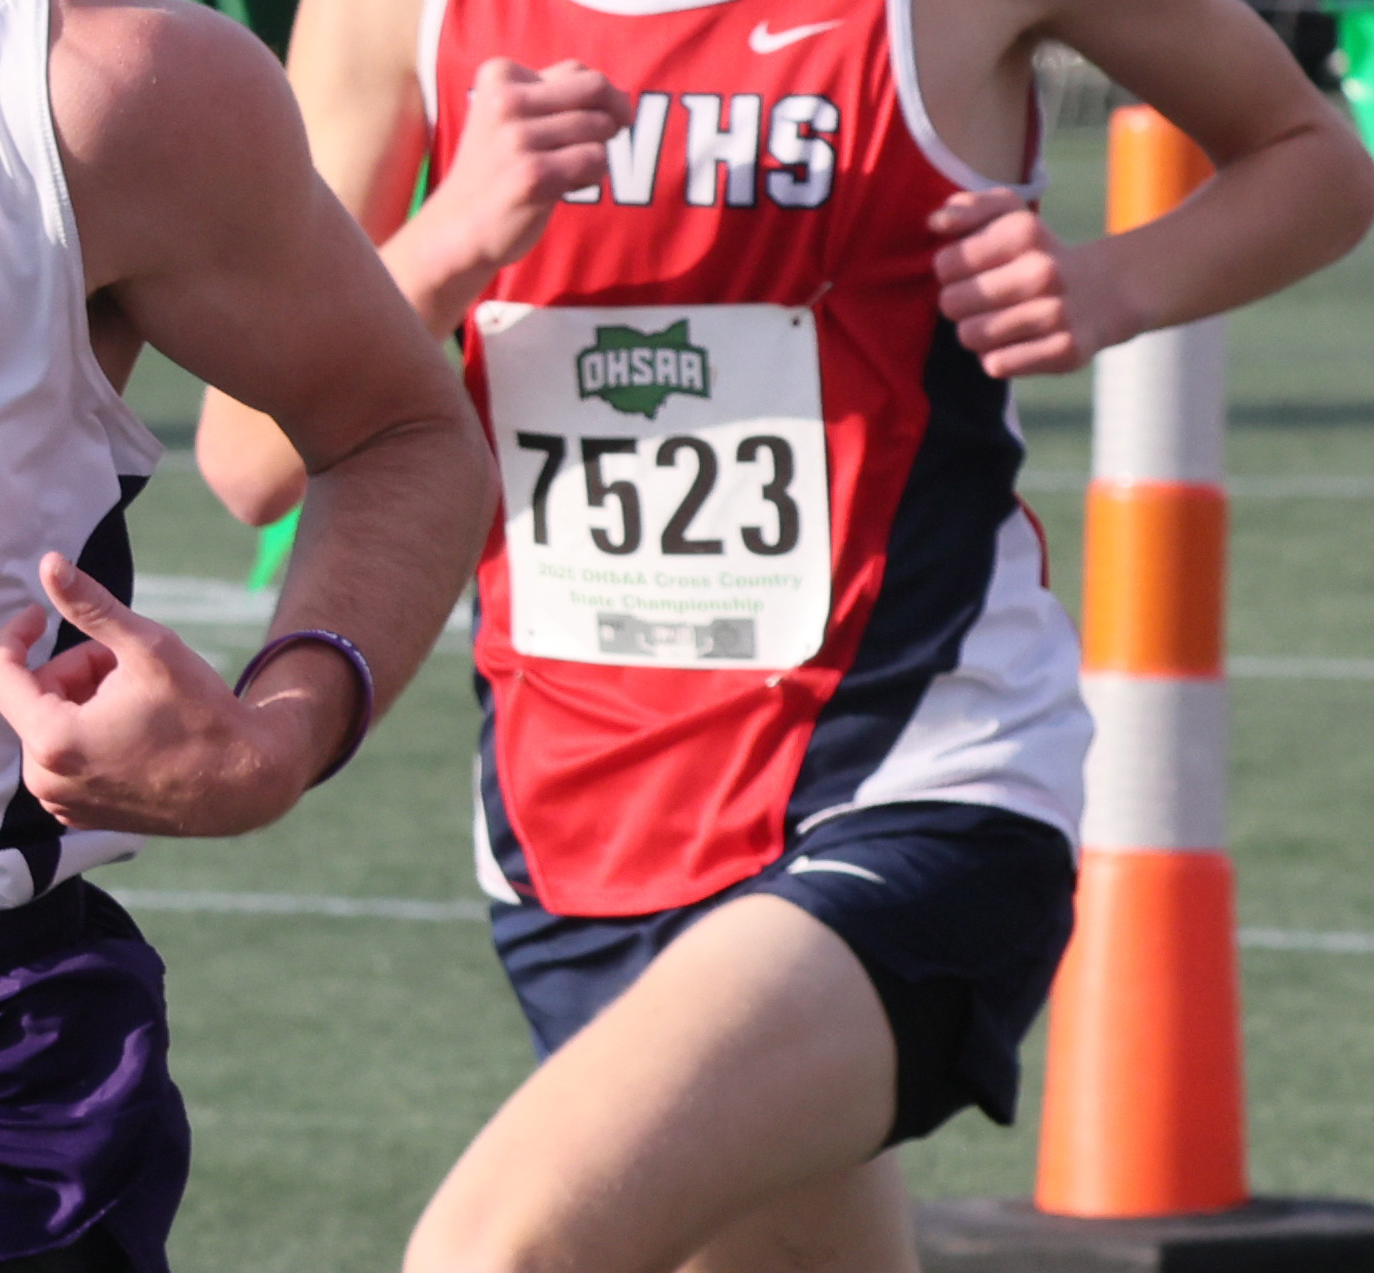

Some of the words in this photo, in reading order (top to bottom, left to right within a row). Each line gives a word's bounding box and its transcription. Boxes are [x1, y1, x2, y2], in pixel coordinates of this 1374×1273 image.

[581, 347, 705, 393] OHSAA
[516, 432, 801, 556] 7523
[654, 571, 712, 589] Cross
[719, 571, 803, 591] Country
[623, 592, 765, 613] Championship
